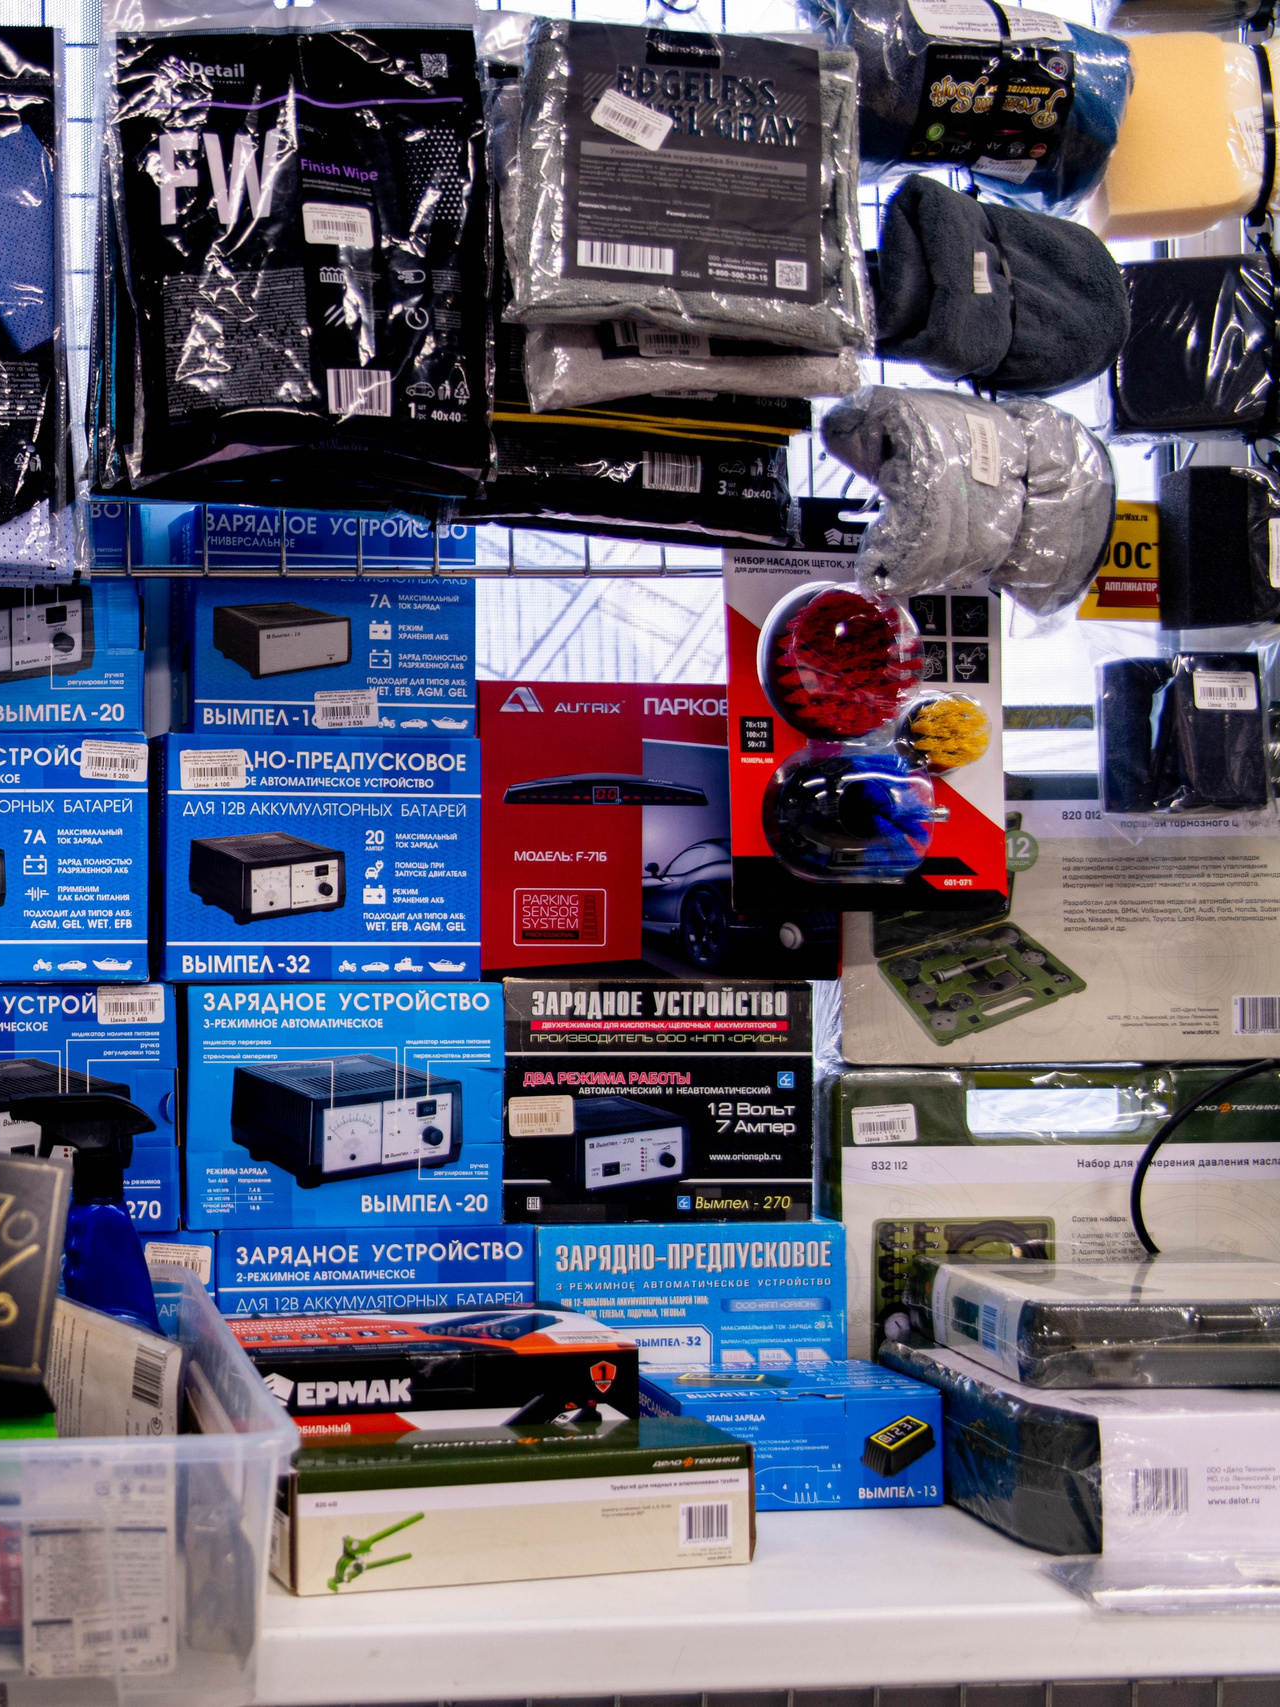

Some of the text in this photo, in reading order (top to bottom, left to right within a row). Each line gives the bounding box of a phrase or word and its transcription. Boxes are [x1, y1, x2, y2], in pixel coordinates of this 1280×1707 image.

[190, 62, 245, 78] Detail
[618, 65, 778, 109] EDGELESS
[715, 110, 801, 147] GRAY
[300, 158, 379, 181] Finish Wipe
[159, 128, 279, 225] FW
[708, 268, 768, 281] 8-800-500-33-15
[719, 481, 727, 495] 3
[734, 556, 845, 570] НАБОР НАСАДОК ЩЕТОК,
[734, 566, 811, 576] ДЛЯ ДРЕЛИ-ШУРУПОВЕРТА
[1105, 582, 1157, 591] АППЛИКАТОР
[91, 704, 124, 721] -20
[554, 702, 620, 714] AUTRIX
[644, 698, 728, 717] ПАРКОВ
[244, 751, 466, 773] ДНО-ПРЕДПУСКОВОЕ
[260, 776, 434, 789] АВТОМАТИЧЕСКОЕ УСТРОЙСТВО
[64, 797, 133, 813] БАТАРЕЙ
[1062, 811, 1101, 820] 820 012
[23, 830, 46, 844] 7А
[57, 827, 123, 837] МАКСИМАЛЬНЫЙ
[365, 830, 385, 845] 20
[57, 858, 132, 866] ЗАРЯД ПОЛНОСТЬЮ
[514, 852, 607, 862] МОДЕЛЬ: F-716
[57, 866, 113, 874] РАЗРЯЖЕННОЙ
[395, 862, 428, 870] ПОМОЩЬ
[427, 870, 467, 878] ДВИГАТЕЛЯ
[944, 878, 972, 886] 601-071
[522, 894, 579, 906] PARKING
[522, 906, 578, 917] SENSOR
[30, 919, 132, 930] AGM, GEL, WET, EFB
[522, 918, 579, 929] SYSTEM
[182, 955, 310, 973] ВЫМПЕЛ -32
[203, 990, 490, 1014] ЗАРЯДНОЕ УСТРОЙСТВО
[531, 987, 787, 1020] ЗАРЯДНОЕ УСТРОЙСТВО
[620, 1022, 711, 1030] КИСЛОТНЫХ/ЩЕЛОЧНЫХ
[530, 1035, 787, 1044] ПРОИЗВОДИТЕЛЬ ООО «НПП «ОРИОН»
[523, 1072, 691, 1087] ДВА РЕЖИМА РАБОТЫ
[578, 1086, 770, 1095] АВТОМАТИЧЕСКИЙ И НЕАВТОМАТИЧЕСКИЙ
[708, 1103, 795, 1116] 12 Вольт
[717, 1120, 795, 1136] 7 Ампер
[709, 1152, 781, 1161] www.orionspb.ru
[871, 1160, 908, 1171] 832 112
[361, 1194, 488, 1213] ВЫМПЕЛ -20
[695, 1196, 790, 1209] Вымпел 270
[236, 1245, 359, 1267] ЗАРЯДНОЕ
[372, 1240, 523, 1263] УСТРОЙСТВО
[236, 1269, 415, 1282] 2-РЕЖИМНОЕ АВТОМАТИЧЕСКОЕ
[643, 1277, 831, 1289] АВТОМАТИЧЕСКОЕ УСТРОЙСТВО
[297, 1378, 411, 1405] ЕРМАК
[706, 1414, 765, 1422] ЭТАПЫ ЗАРЯДА
[858, 1486, 937, 1500] ВЫМПЕЛ -13
[1207, 1497, 1260, 1506] www.delot.ru
